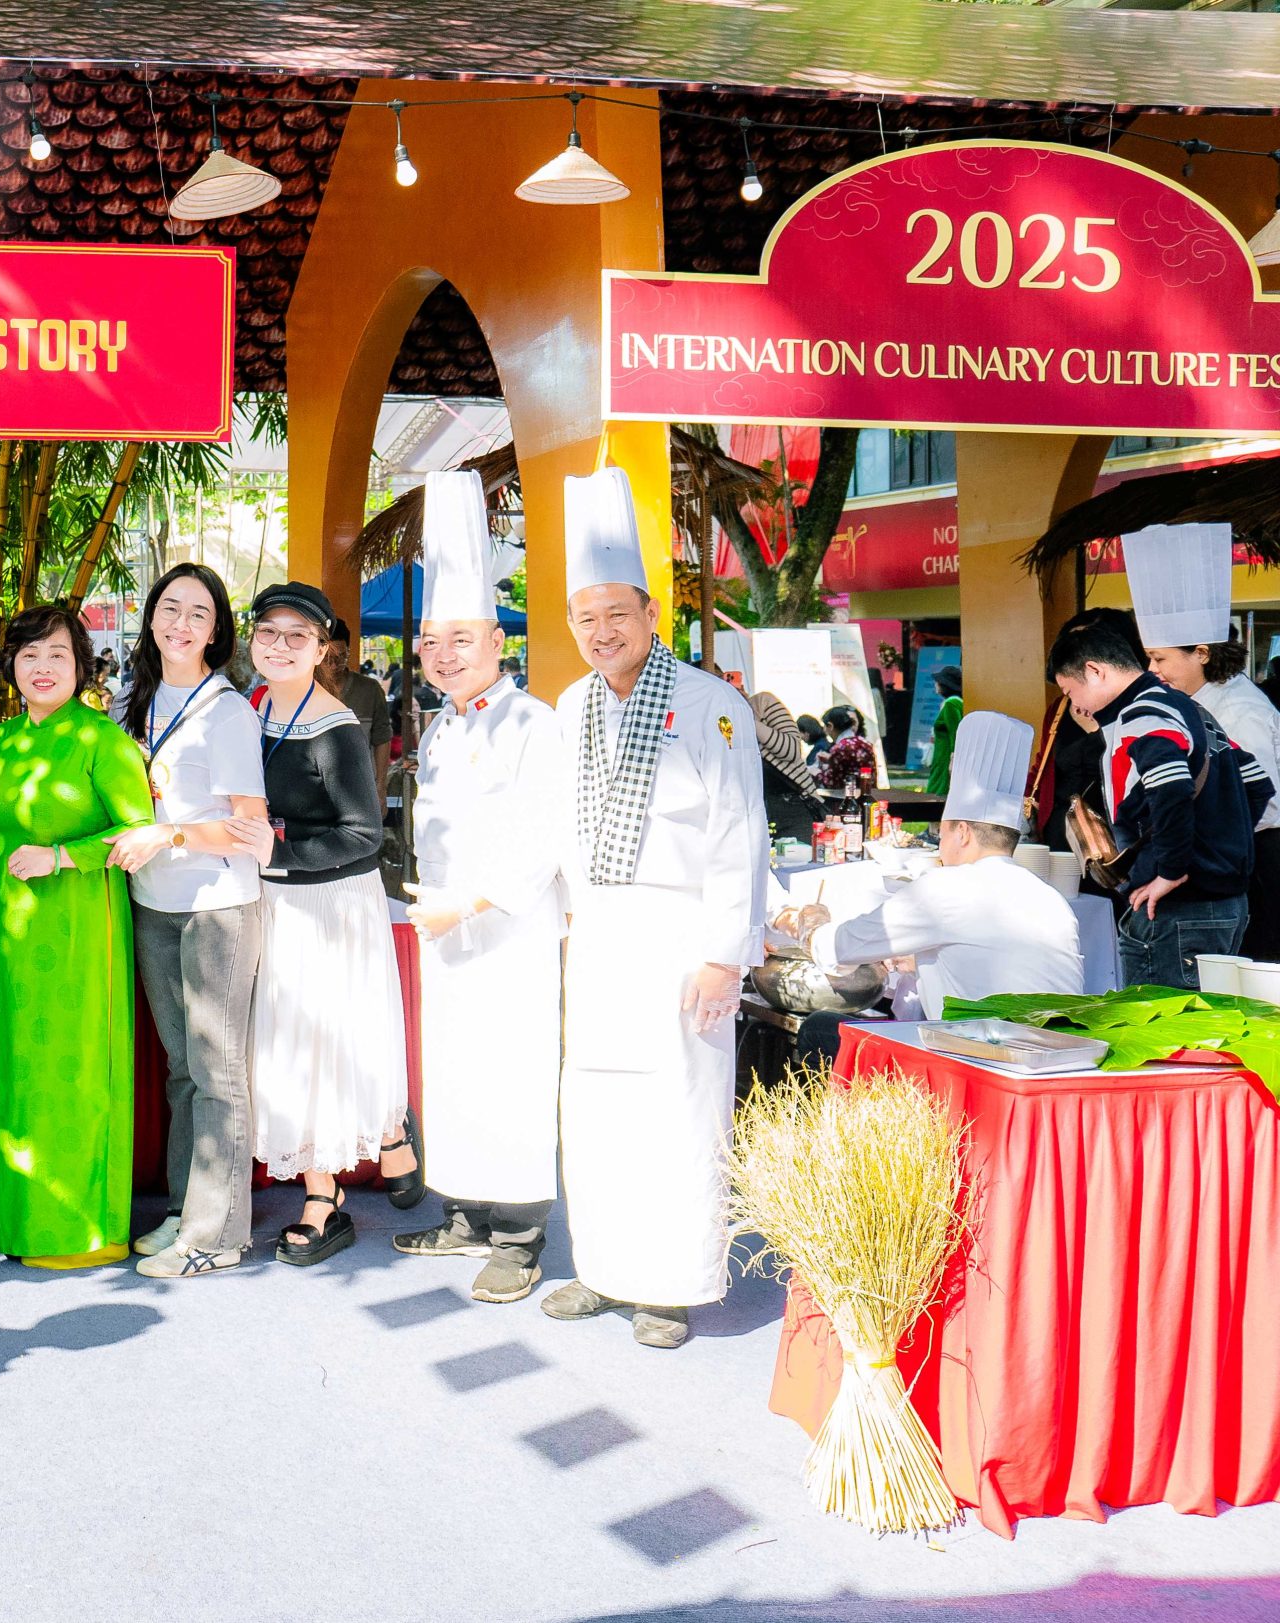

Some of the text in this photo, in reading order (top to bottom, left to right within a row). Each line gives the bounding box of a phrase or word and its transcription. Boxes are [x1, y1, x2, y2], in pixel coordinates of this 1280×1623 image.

[906, 208, 1121, 293] 2025
[621, 332, 865, 376] INTERNATION
[873, 341, 1055, 383] CULINARY
[1060, 348, 1221, 387] CULTURE
